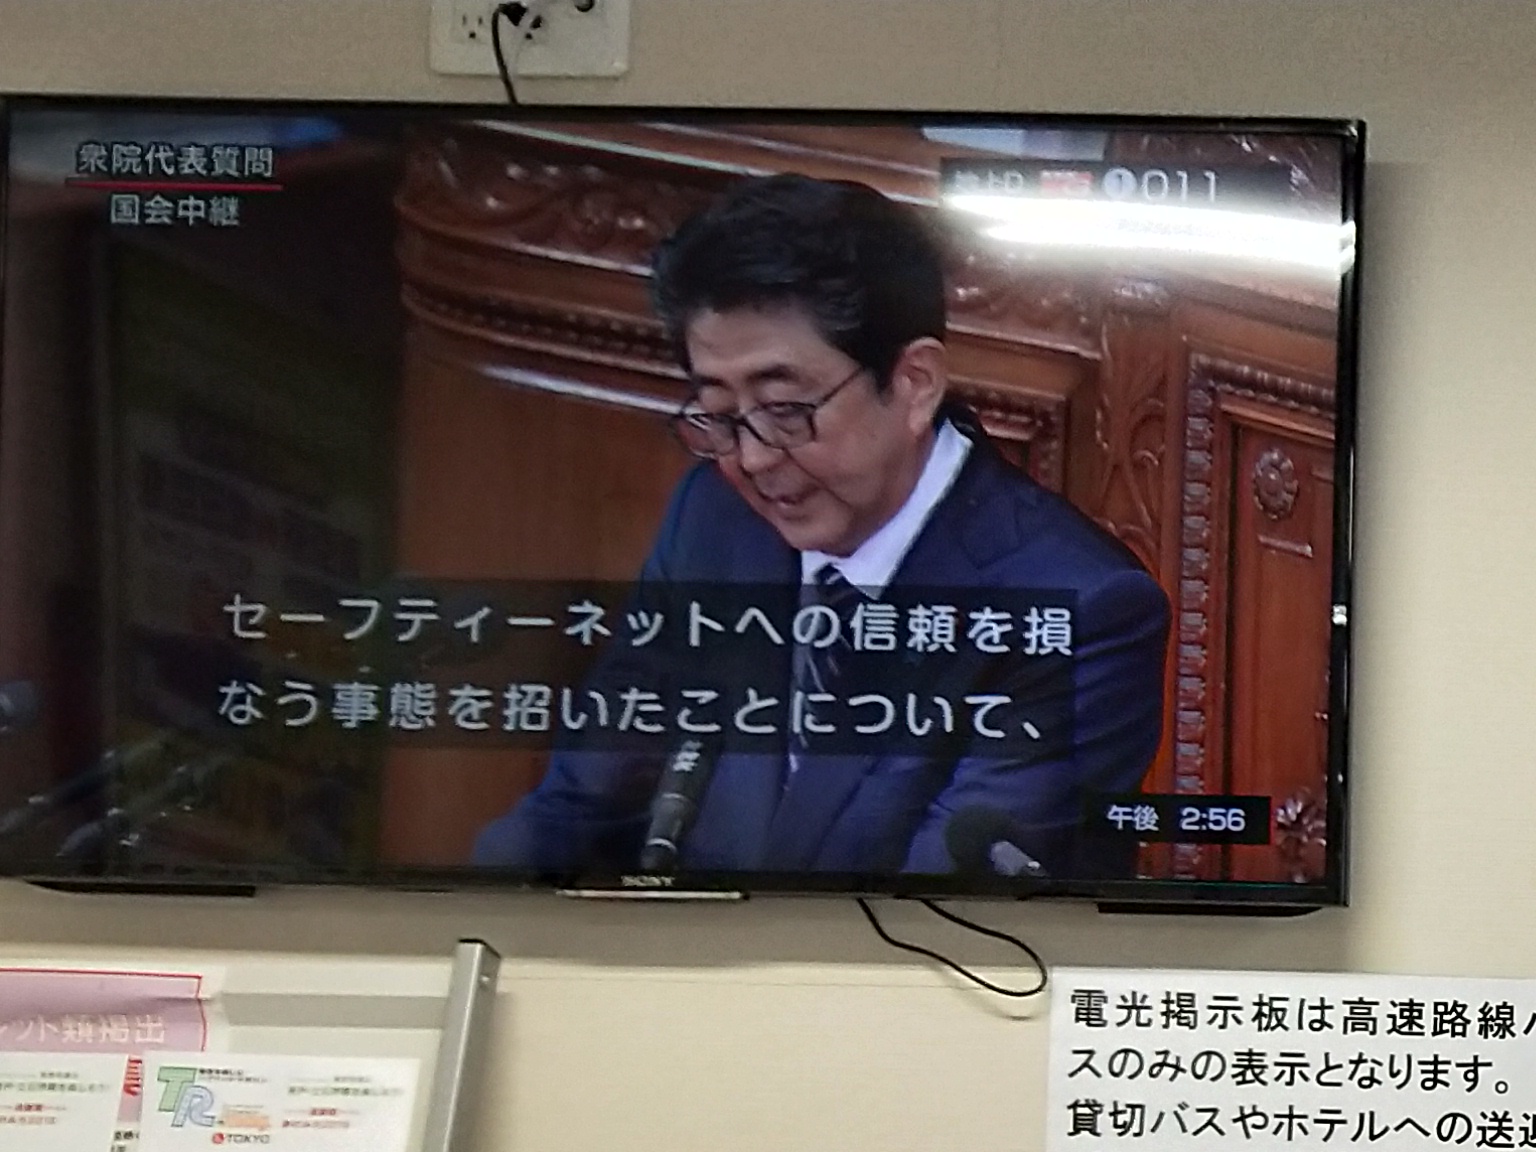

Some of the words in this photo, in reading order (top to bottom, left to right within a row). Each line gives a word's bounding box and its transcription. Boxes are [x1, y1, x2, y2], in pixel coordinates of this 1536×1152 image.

[78, 143, 273, 177] 衆院代表質問
[110, 195, 239, 227] 国会中継
[223, 594, 1074, 656] セーフティーネットへの信頼を損
[218, 680, 1042, 741] なう事態を招いたことについて、
[1107, 805, 1159, 832] 午後
[1181, 807, 1245, 832] 2:56
[1068, 1047, 1509, 1094] スのみの表示となります。
